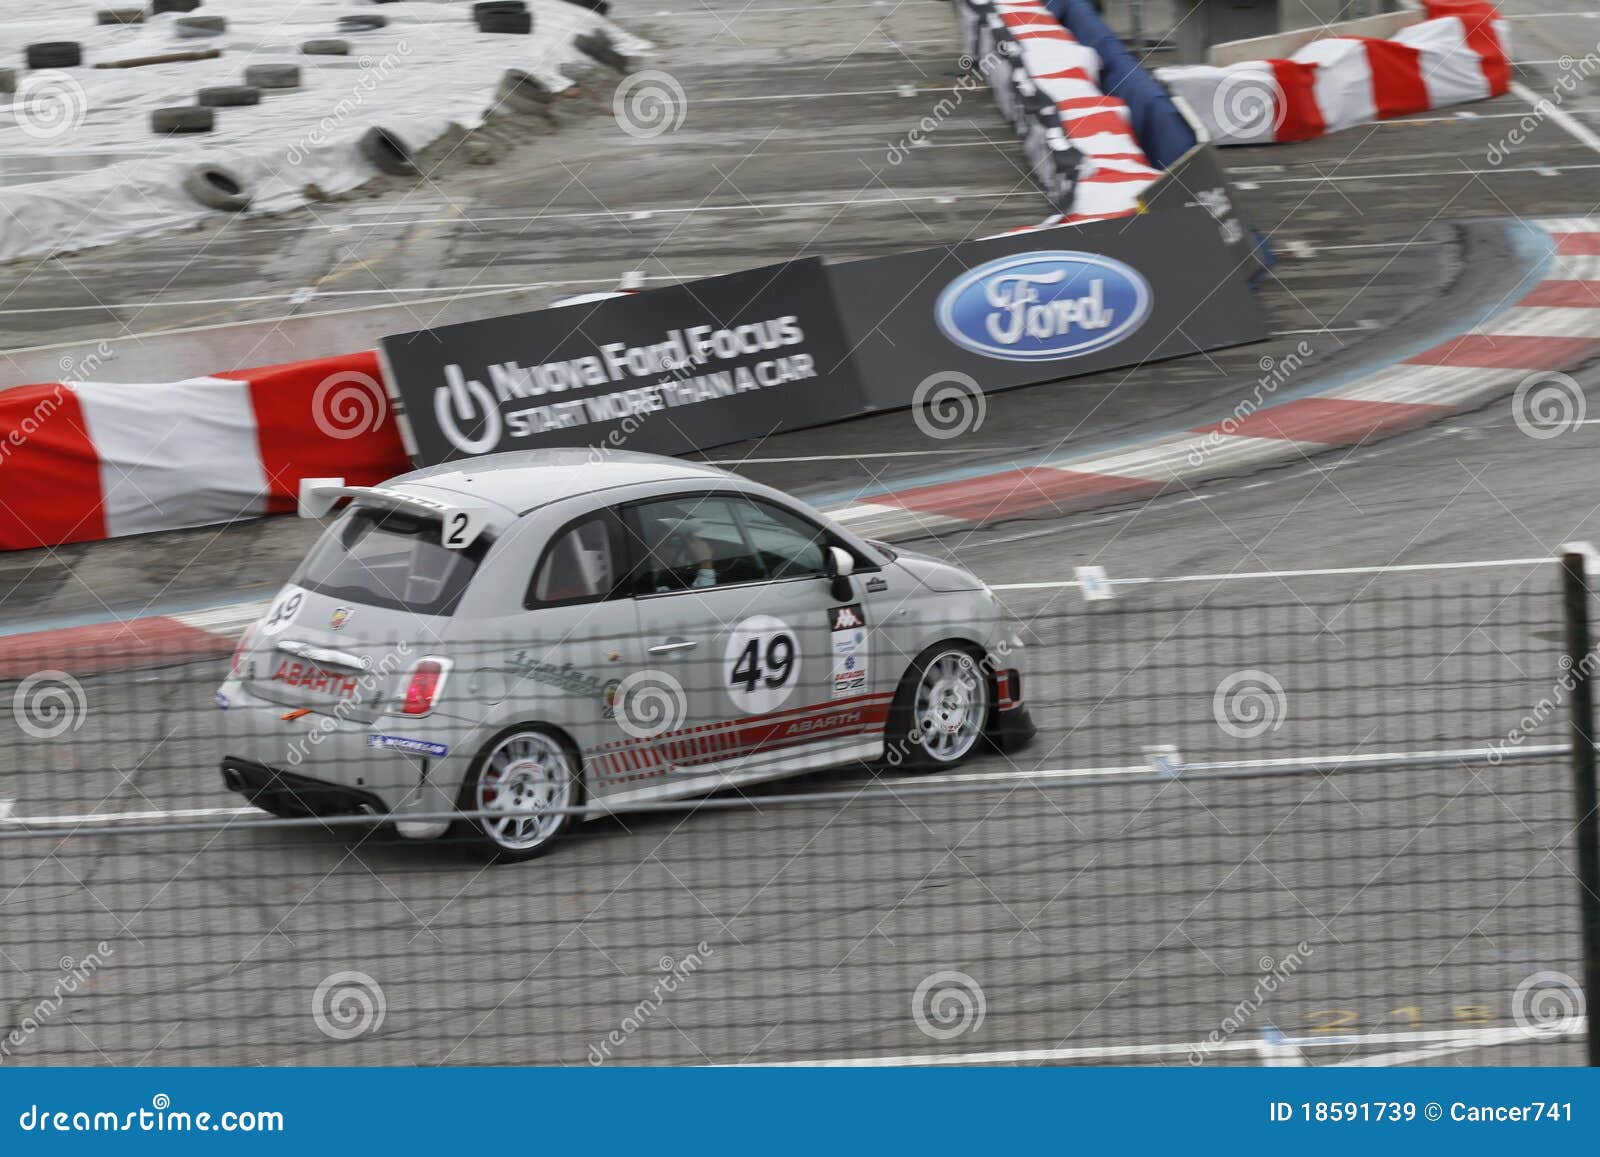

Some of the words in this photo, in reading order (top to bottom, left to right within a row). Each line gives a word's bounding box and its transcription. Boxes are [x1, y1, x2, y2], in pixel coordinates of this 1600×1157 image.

[985, 269, 1114, 344] Ford
[488, 355, 608, 401] Nuova
[600, 329, 686, 382] Ford
[687, 315, 804, 365] Focus
[504, 399, 590, 438] START
[584, 383, 668, 423] MORE
[659, 369, 734, 409] THAN
[731, 367, 759, 393] A
[756, 353, 818, 386] CAR
[447, 512, 469, 545] 2
[266, 592, 304, 627] 49
[271, 660, 362, 701] ABARTH
[730, 632, 796, 694] 49
[785, 711, 863, 736] ABARTH
